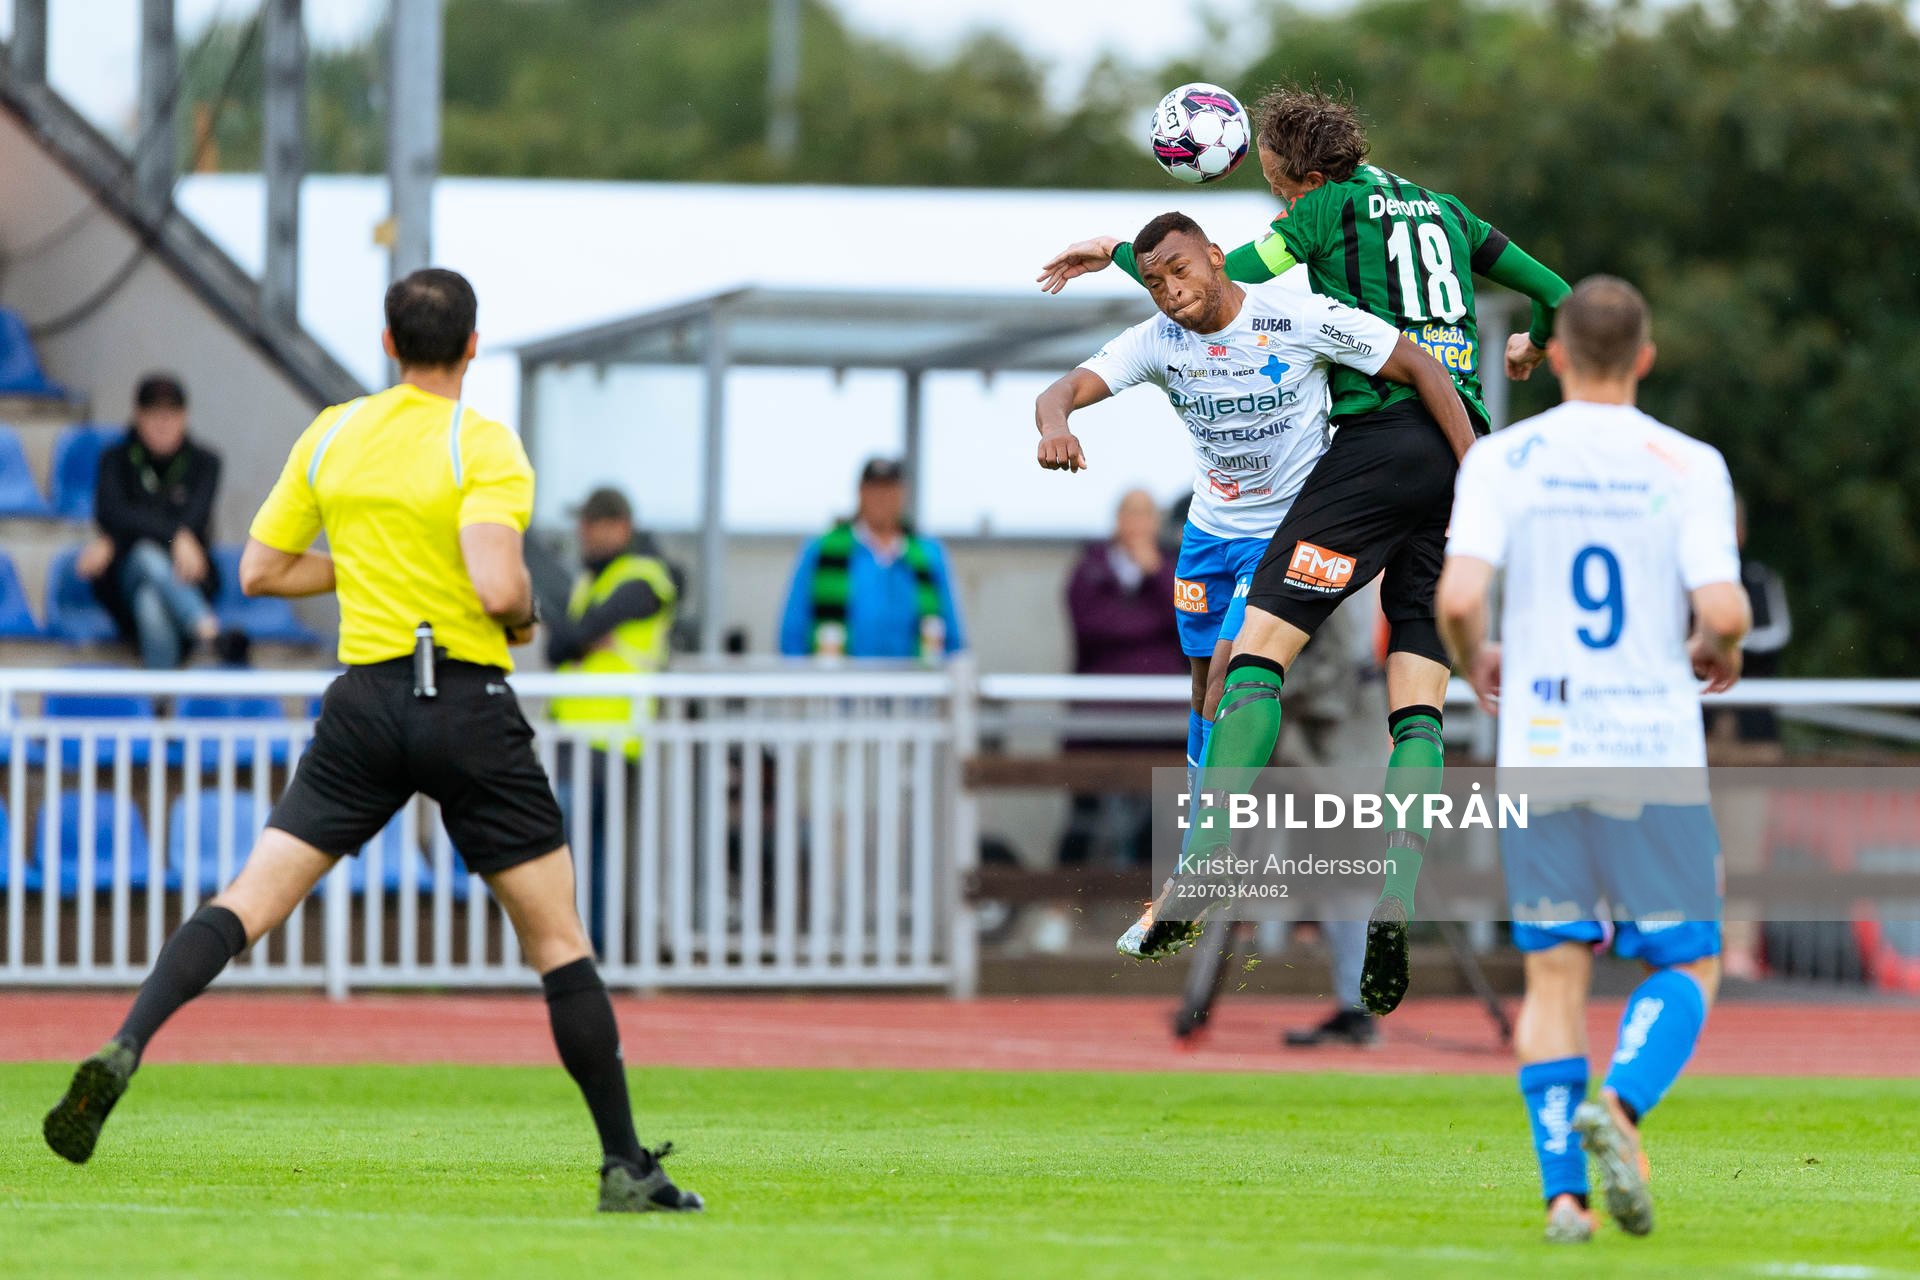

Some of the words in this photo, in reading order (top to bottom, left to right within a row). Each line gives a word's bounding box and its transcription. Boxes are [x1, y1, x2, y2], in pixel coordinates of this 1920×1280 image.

[1387, 221, 1468, 323] 18
[1207, 345, 1227, 356] 3M
[1319, 322, 1373, 356] stadium
[1293, 544, 1352, 580] FMP
[1571, 545, 1624, 649] 9
